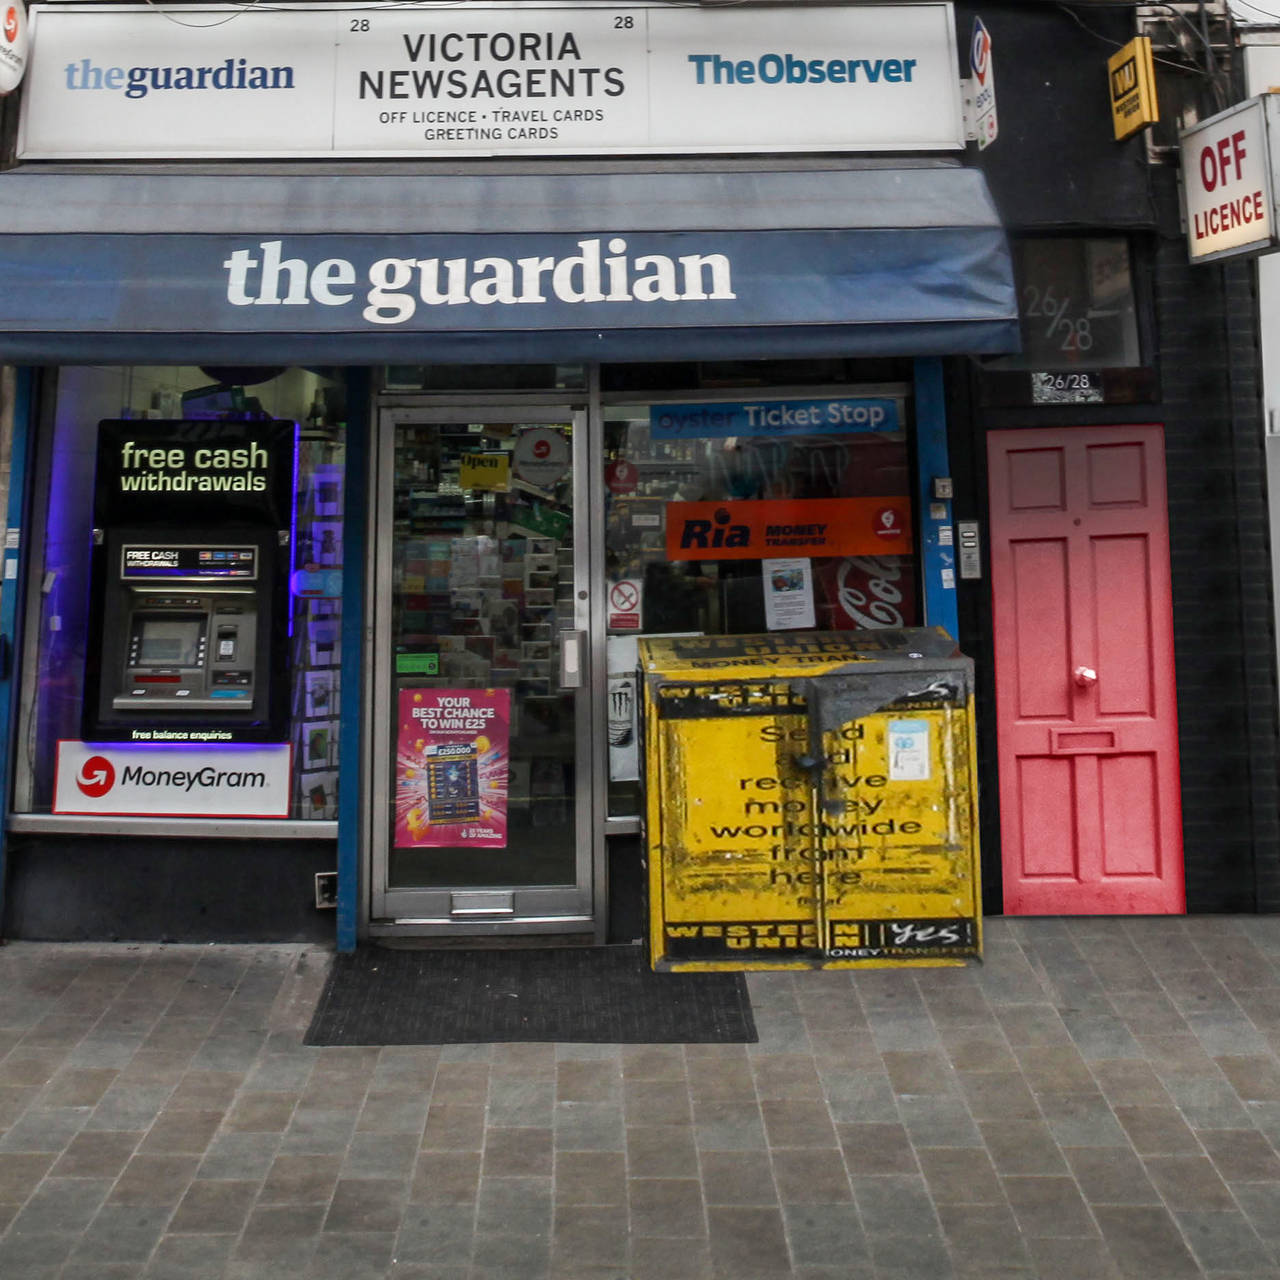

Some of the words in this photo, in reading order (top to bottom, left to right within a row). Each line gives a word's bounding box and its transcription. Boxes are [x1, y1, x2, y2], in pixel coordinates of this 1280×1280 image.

[349, 19, 370, 32] 28
[614, 16, 634, 29] 28
[403, 32, 581, 62] VICTORIA
[359, 67, 624, 99] NEWSAGENTS
[379, 111, 407, 124] OFF
[413, 111, 476, 123] LICENCE
[492, 110, 548, 122] TRAVEL
[553, 109, 604, 122] CARDS
[425, 128, 502, 140] GREETING
[507, 127, 559, 140] CARDS
[1200, 130, 1246, 192] OFF
[1194, 191, 1264, 240] LICENCE
[363, 238, 736, 324] guardian
[1047, 374, 1090, 389] 26/28
[659, 411, 735, 432] oyster
[744, 405, 820, 426] Ticket
[827, 403, 884, 426] Stop
[121, 442, 185, 468] free
[194, 442, 268, 468] cash
[461, 454, 499, 469] Open
[121, 471, 266, 491] withdrawals
[680, 508, 750, 549] Ria
[766, 524, 827, 536] MONEY
[766, 537, 827, 547] TRANSFER
[126, 551, 150, 560] FREE
[151, 551, 179, 560] CASH
[691, 657, 780, 669] MONEY
[437, 697, 470, 708] YOUR
[412, 708, 443, 718] BEST
[444, 708, 495, 718] CHANCE
[422, 719, 438, 729] TO
[438, 719, 464, 729] WIN
[465, 719, 486, 729] £25
[132, 730, 151, 739] free
[153, 730, 188, 739] balance
[190, 730, 232, 741] enquiries
[121, 766, 265, 792] MoneyGram
